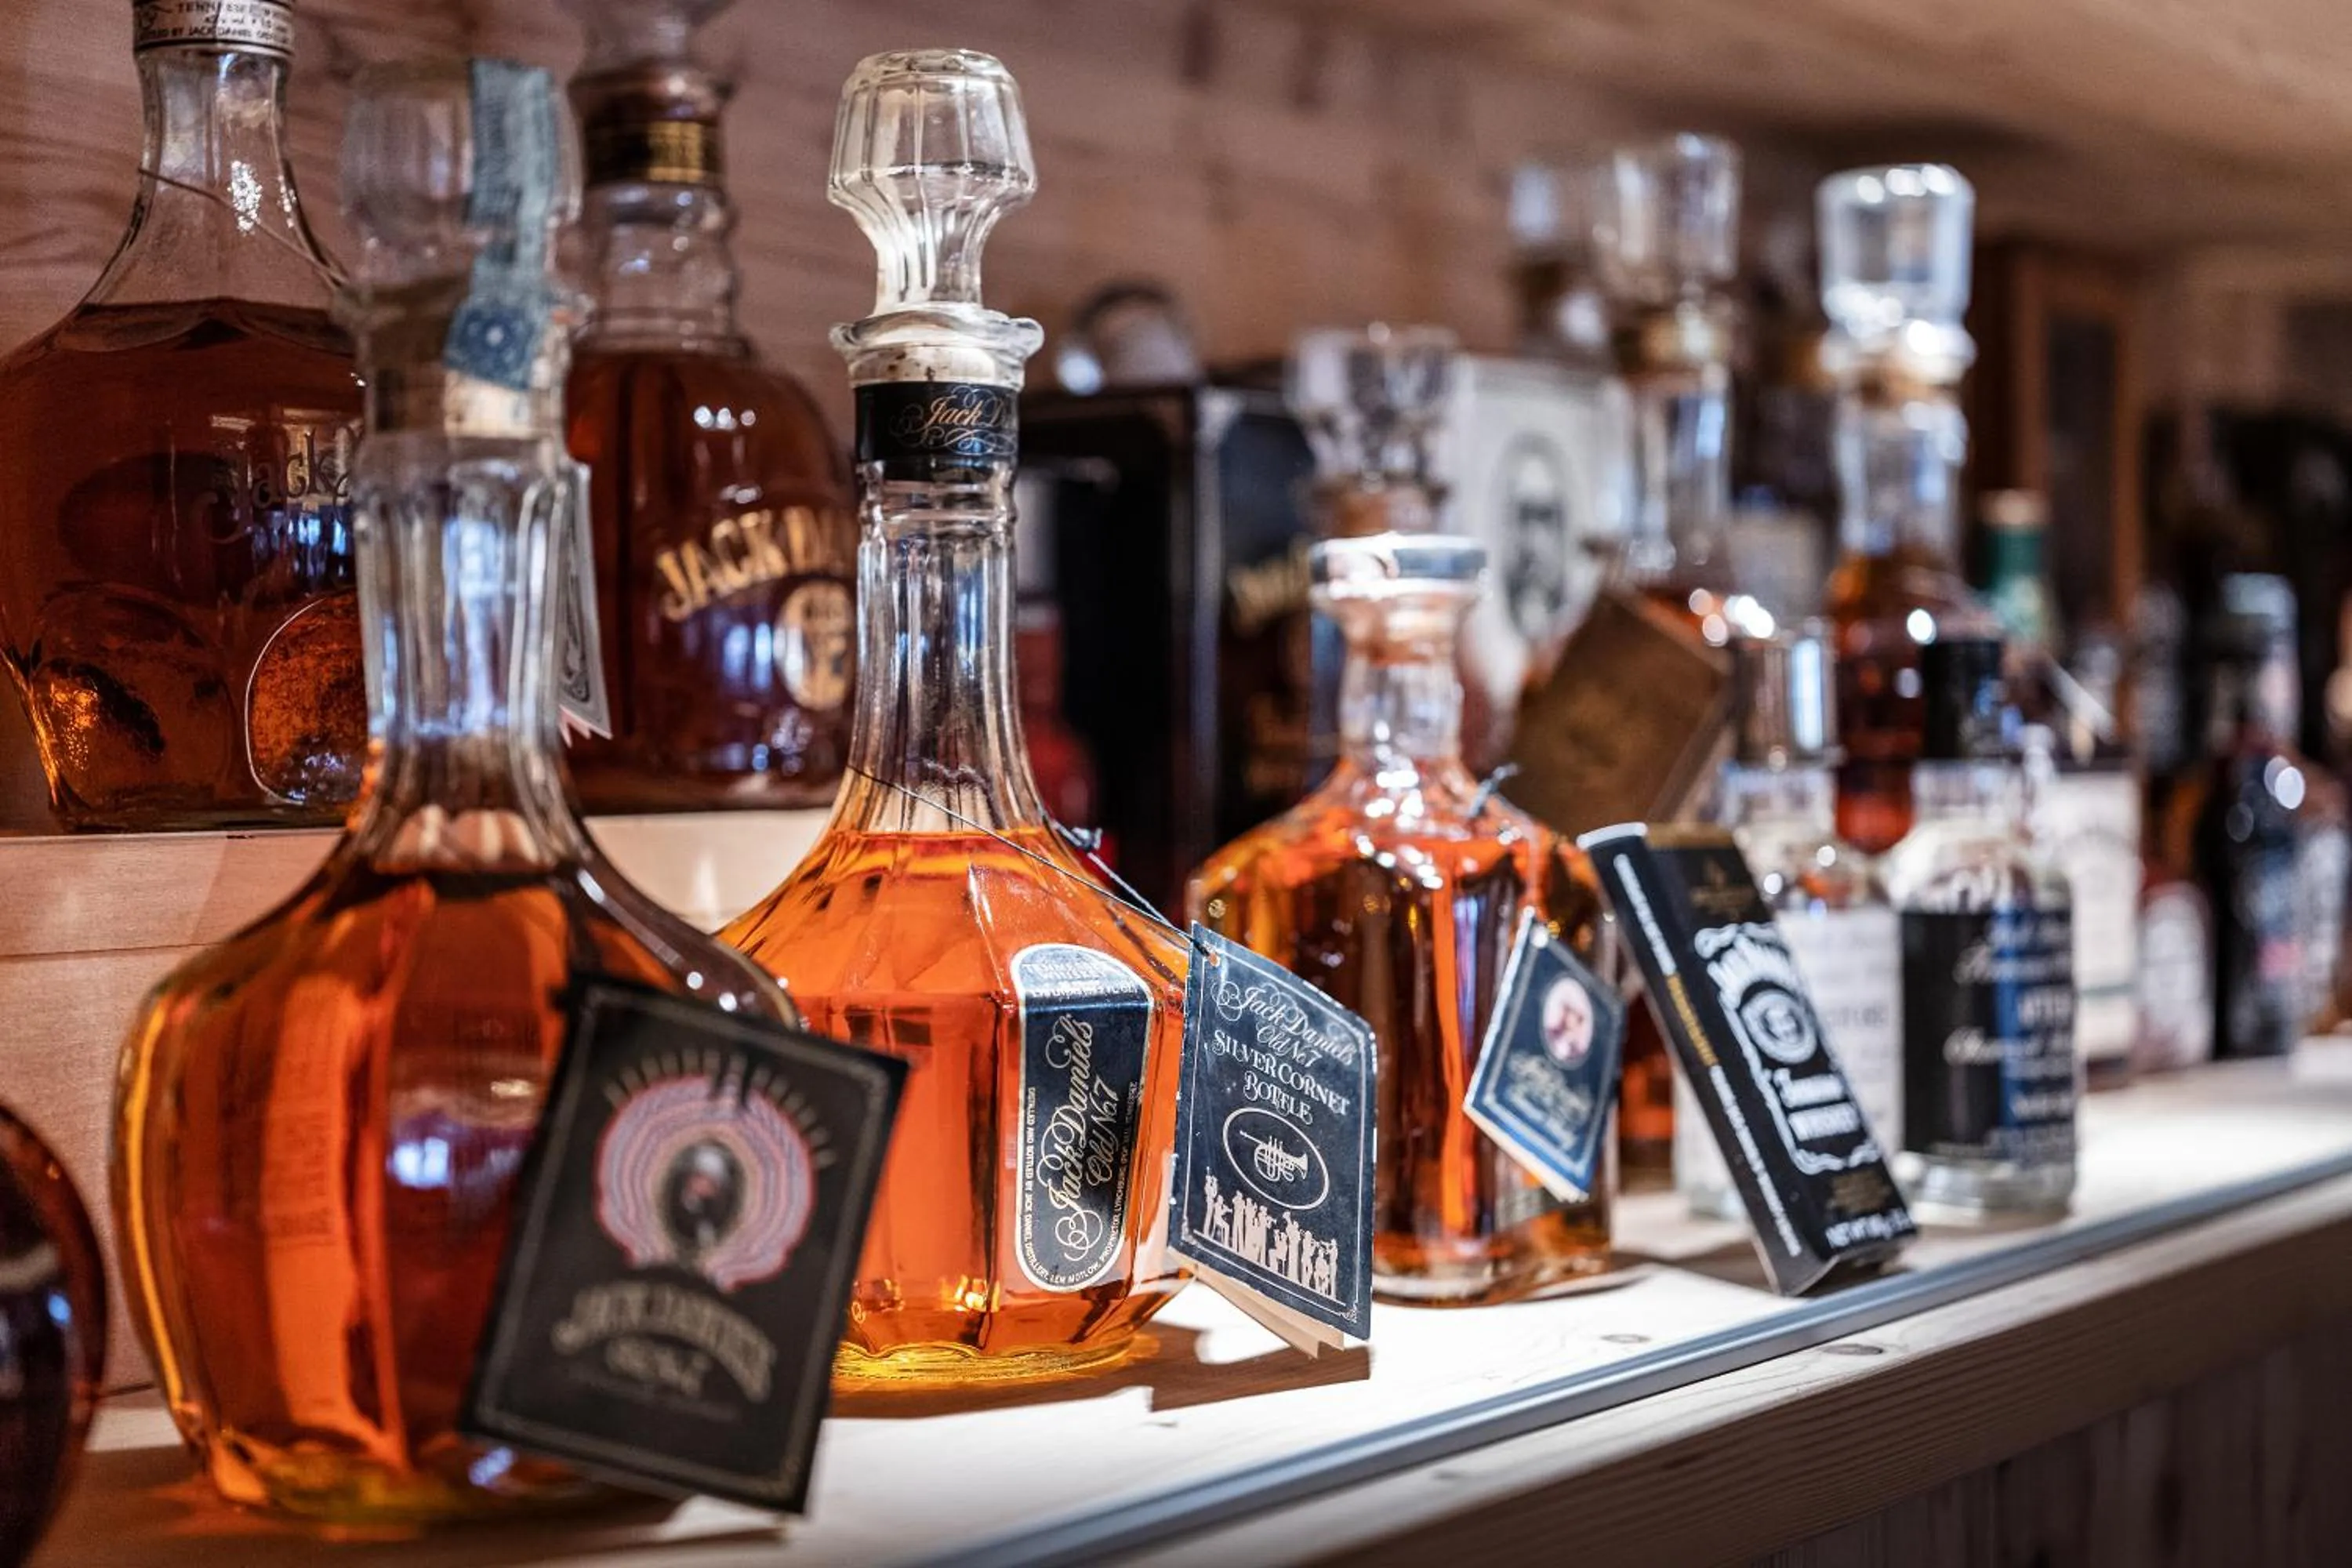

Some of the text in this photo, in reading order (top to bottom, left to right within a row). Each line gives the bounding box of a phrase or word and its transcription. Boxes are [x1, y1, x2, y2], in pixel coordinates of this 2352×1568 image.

[656, 508, 786, 622] JACK
[1256, 1022, 1291, 1054] Old
[1211, 1029, 1351, 1116] SILVER CORNET
[1243, 1070, 1313, 1125] BOTTLE
[1086, 1129, 1113, 1186] Old
